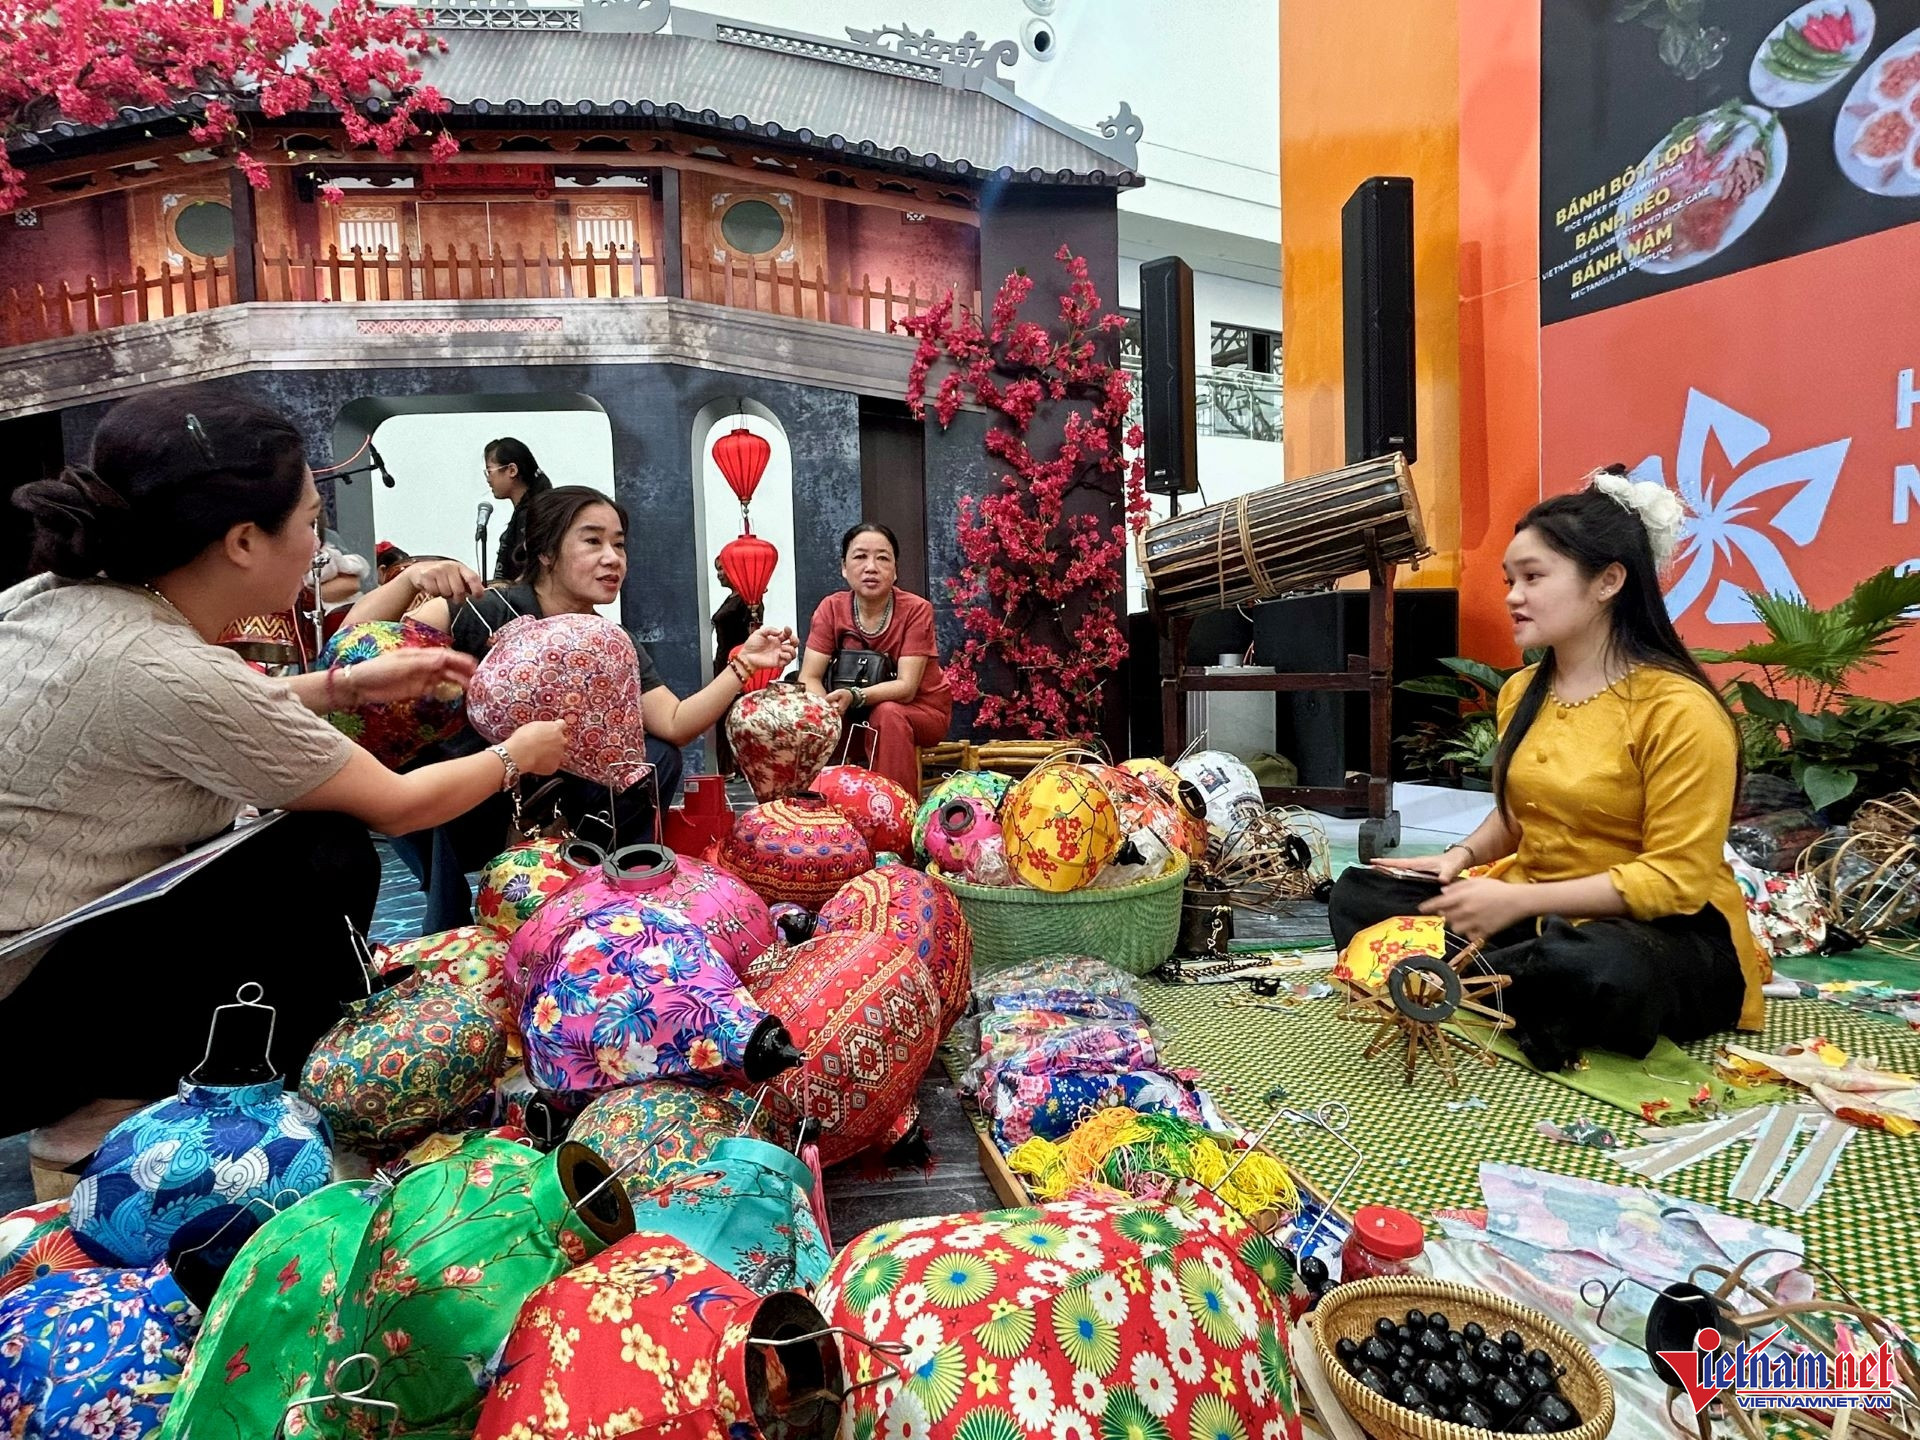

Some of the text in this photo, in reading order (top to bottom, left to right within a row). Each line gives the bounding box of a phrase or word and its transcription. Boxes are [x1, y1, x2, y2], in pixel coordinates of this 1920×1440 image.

[1556, 185, 1605, 226] BÁNH
[1654, 135, 1697, 170] LỌC
[1564, 218, 1582, 232] RICE
[1583, 205, 1608, 223] PAPER
[1660, 161, 1685, 181] PORK
[1541, 186, 1711, 280] VIETNAMESE SAVORY STEAMED RICE CAKE
[1575, 209, 1627, 250] BÁNH
[1570, 244, 1673, 300] RECTANGULAR DUMPLING
[1571, 248, 1623, 288] BÁNH
